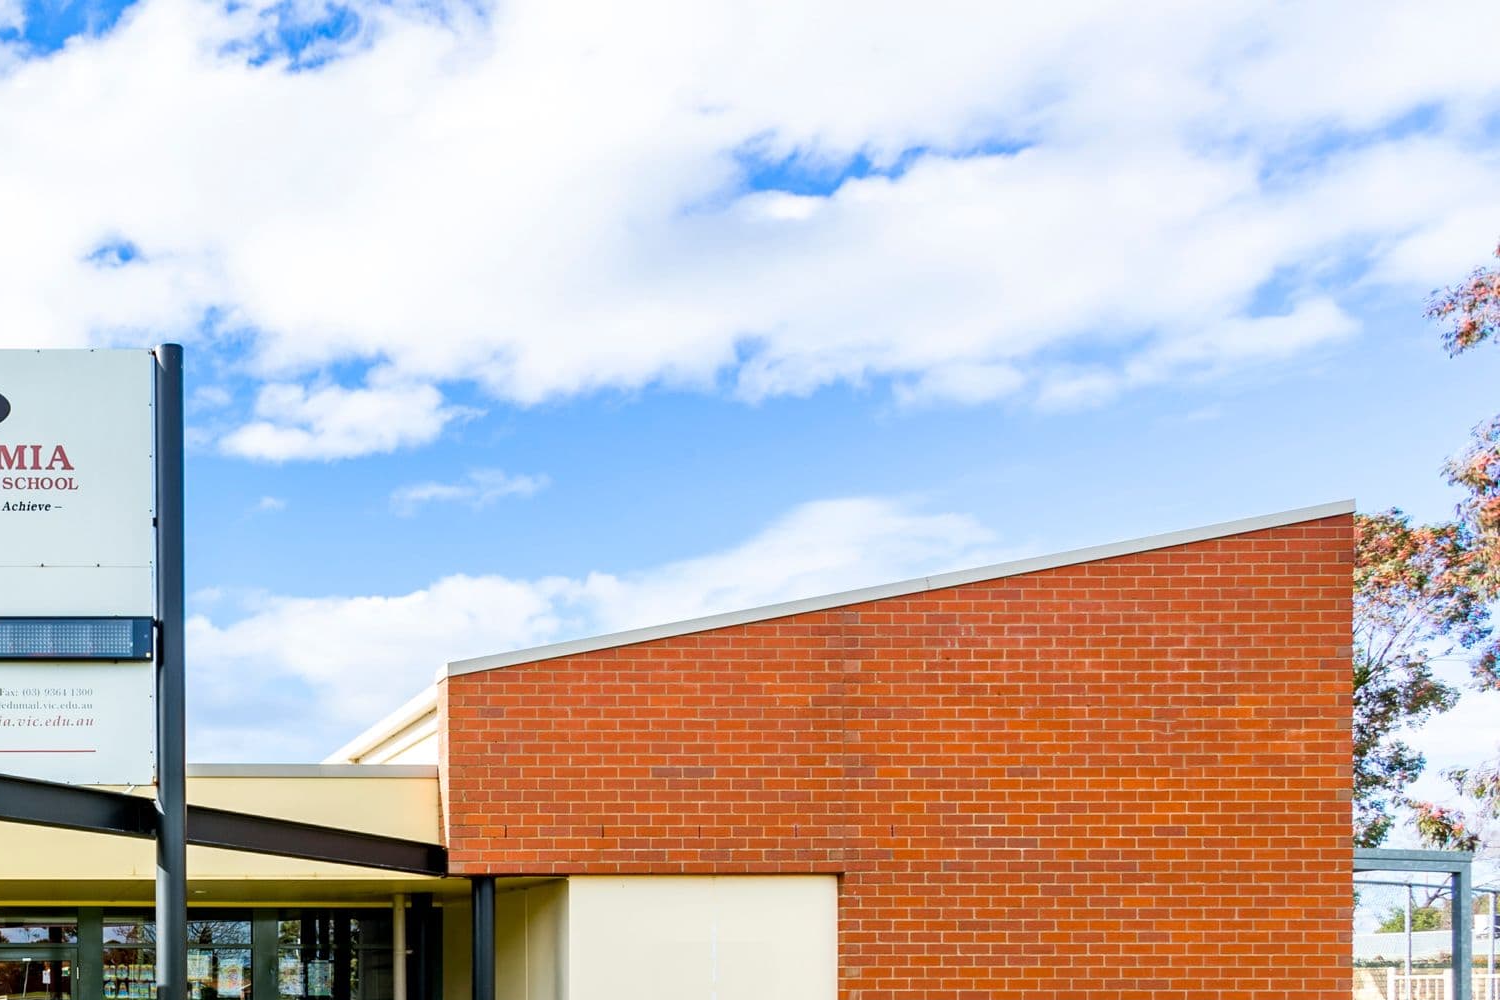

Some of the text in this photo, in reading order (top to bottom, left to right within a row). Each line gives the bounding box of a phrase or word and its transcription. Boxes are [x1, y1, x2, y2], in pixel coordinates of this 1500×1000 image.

[2, 476, 80, 491] SCHOOL
[1, 500, 52, 512] Achieve
[0, 687, 18, 697] Fax:
[22, 687, 41, 697] (03)
